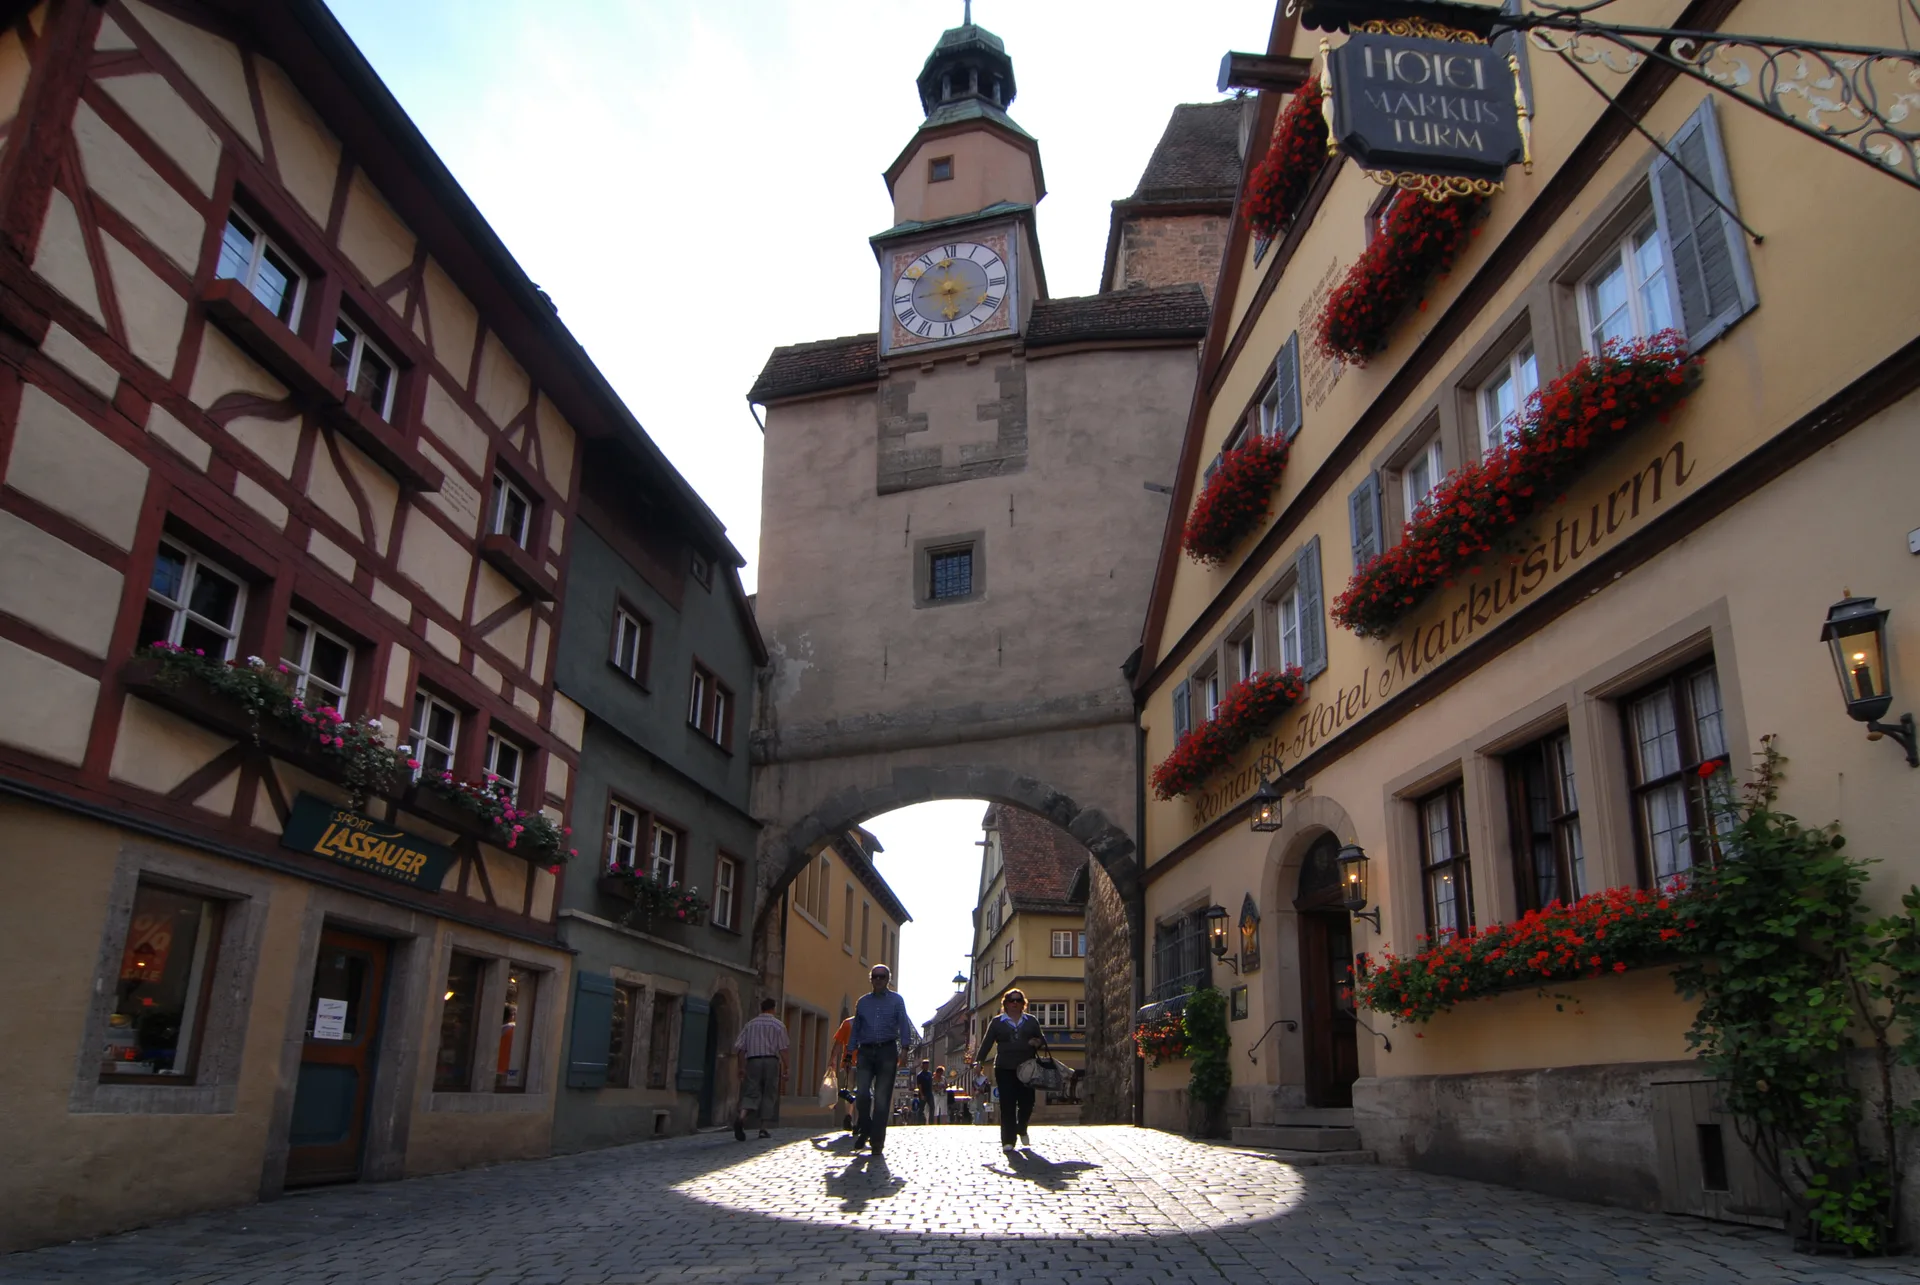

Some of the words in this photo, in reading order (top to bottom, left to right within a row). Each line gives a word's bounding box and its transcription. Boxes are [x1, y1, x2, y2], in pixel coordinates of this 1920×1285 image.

[1364, 88, 1499, 124] MARKUS
[1389, 118, 1484, 152] TURM
[943, 244, 957, 259] XII
[1378, 440, 1697, 698] Markusturm
[334, 810, 374, 832] SPORT
[312, 822, 428, 877] LASSAUER
